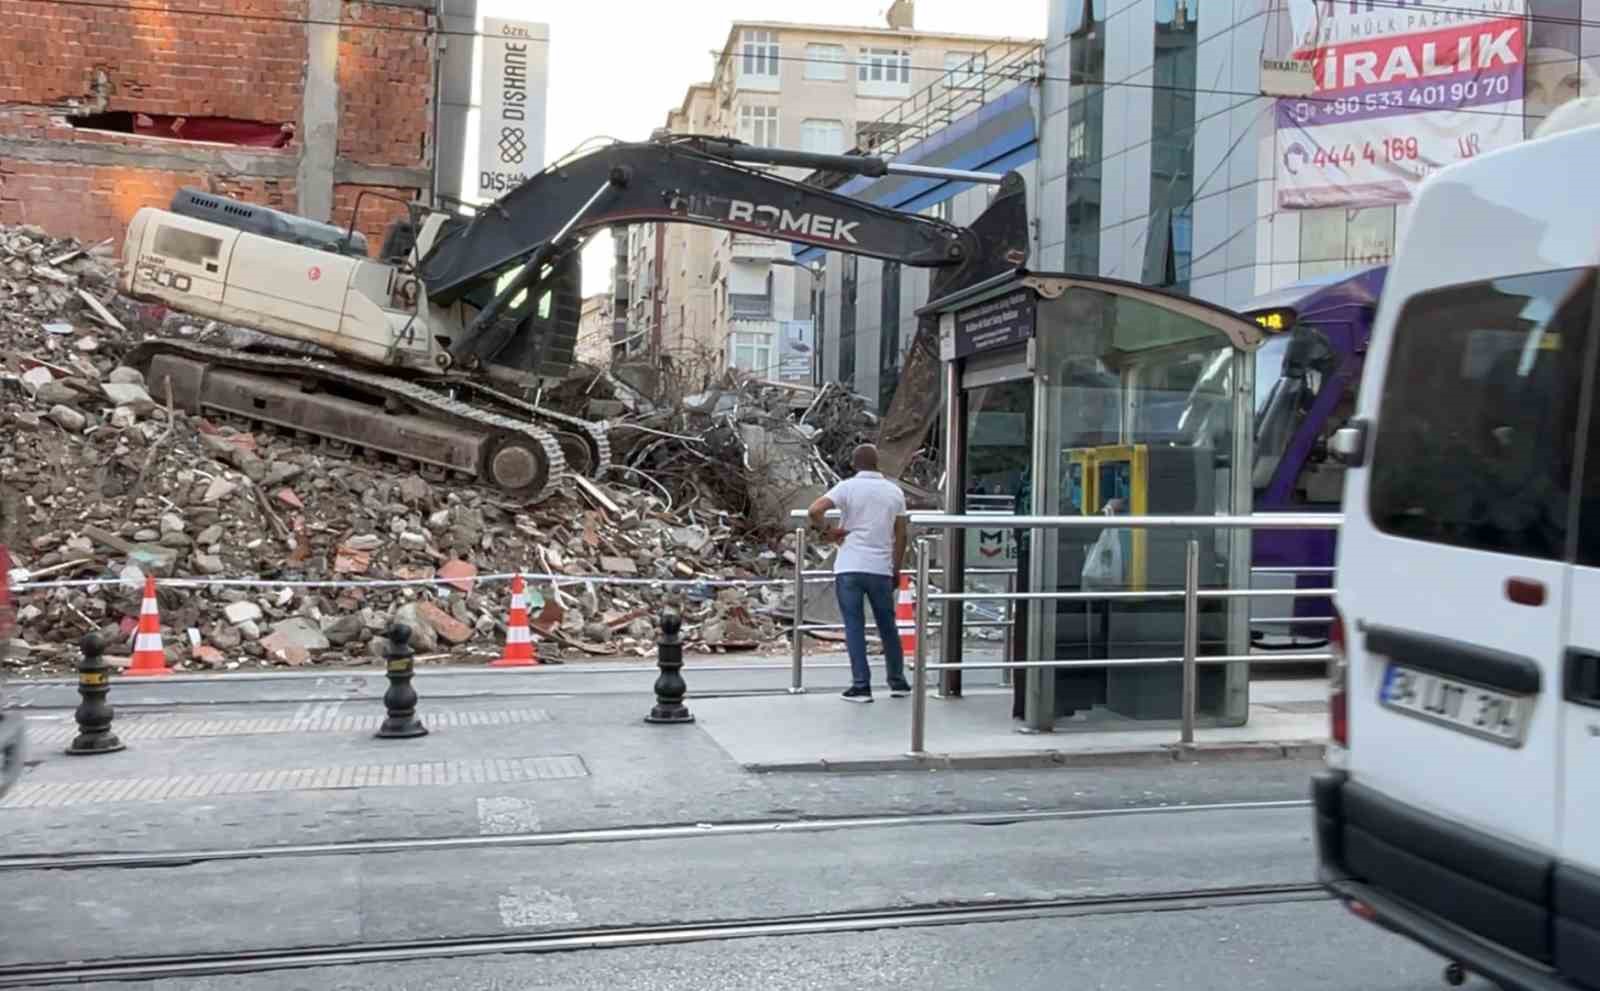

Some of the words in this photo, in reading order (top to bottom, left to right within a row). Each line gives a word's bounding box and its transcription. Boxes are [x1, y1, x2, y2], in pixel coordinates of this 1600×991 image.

[1312, 27, 1519, 91] İRALIK
[1323, 95, 1360, 117] +90
[1365, 89, 1403, 110] 533
[1408, 84, 1445, 105] 401
[1451, 80, 1478, 101] 90
[1483, 75, 1509, 96] 70
[1313, 143, 1355, 168] 444
[1363, 142, 1376, 165] 4
